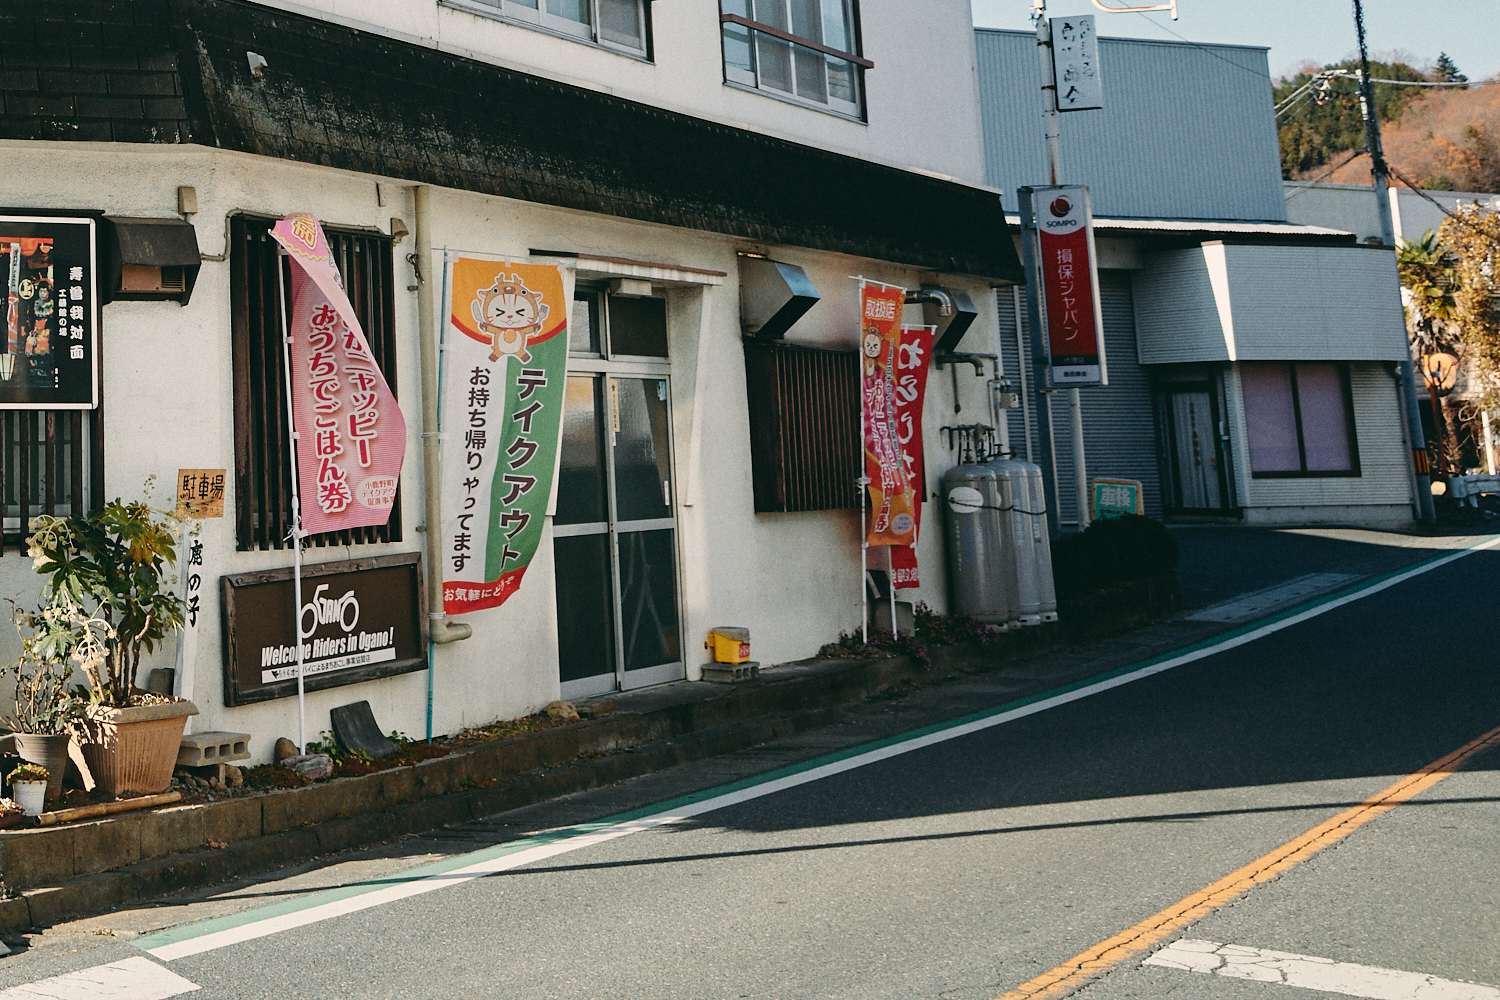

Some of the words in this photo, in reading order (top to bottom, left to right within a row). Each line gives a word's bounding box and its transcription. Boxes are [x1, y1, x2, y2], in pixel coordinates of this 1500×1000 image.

[1046, 220, 1077, 228] SOMPO
[865, 299, 896, 320] 取扱店
[1057, 249, 1078, 341] 損保ジャパン
[307, 303, 350, 511] おうちでごはん券
[180, 473, 224, 500] 駐車場
[451, 366, 490, 573] お持ち帰りやってます
[499, 368, 548, 571] テイクアウト
[1100, 487, 1131, 508] 車検
[189, 539, 203, 627] 鹿の子
[312, 635, 346, 658] Riders
[347, 633, 358, 652] in
